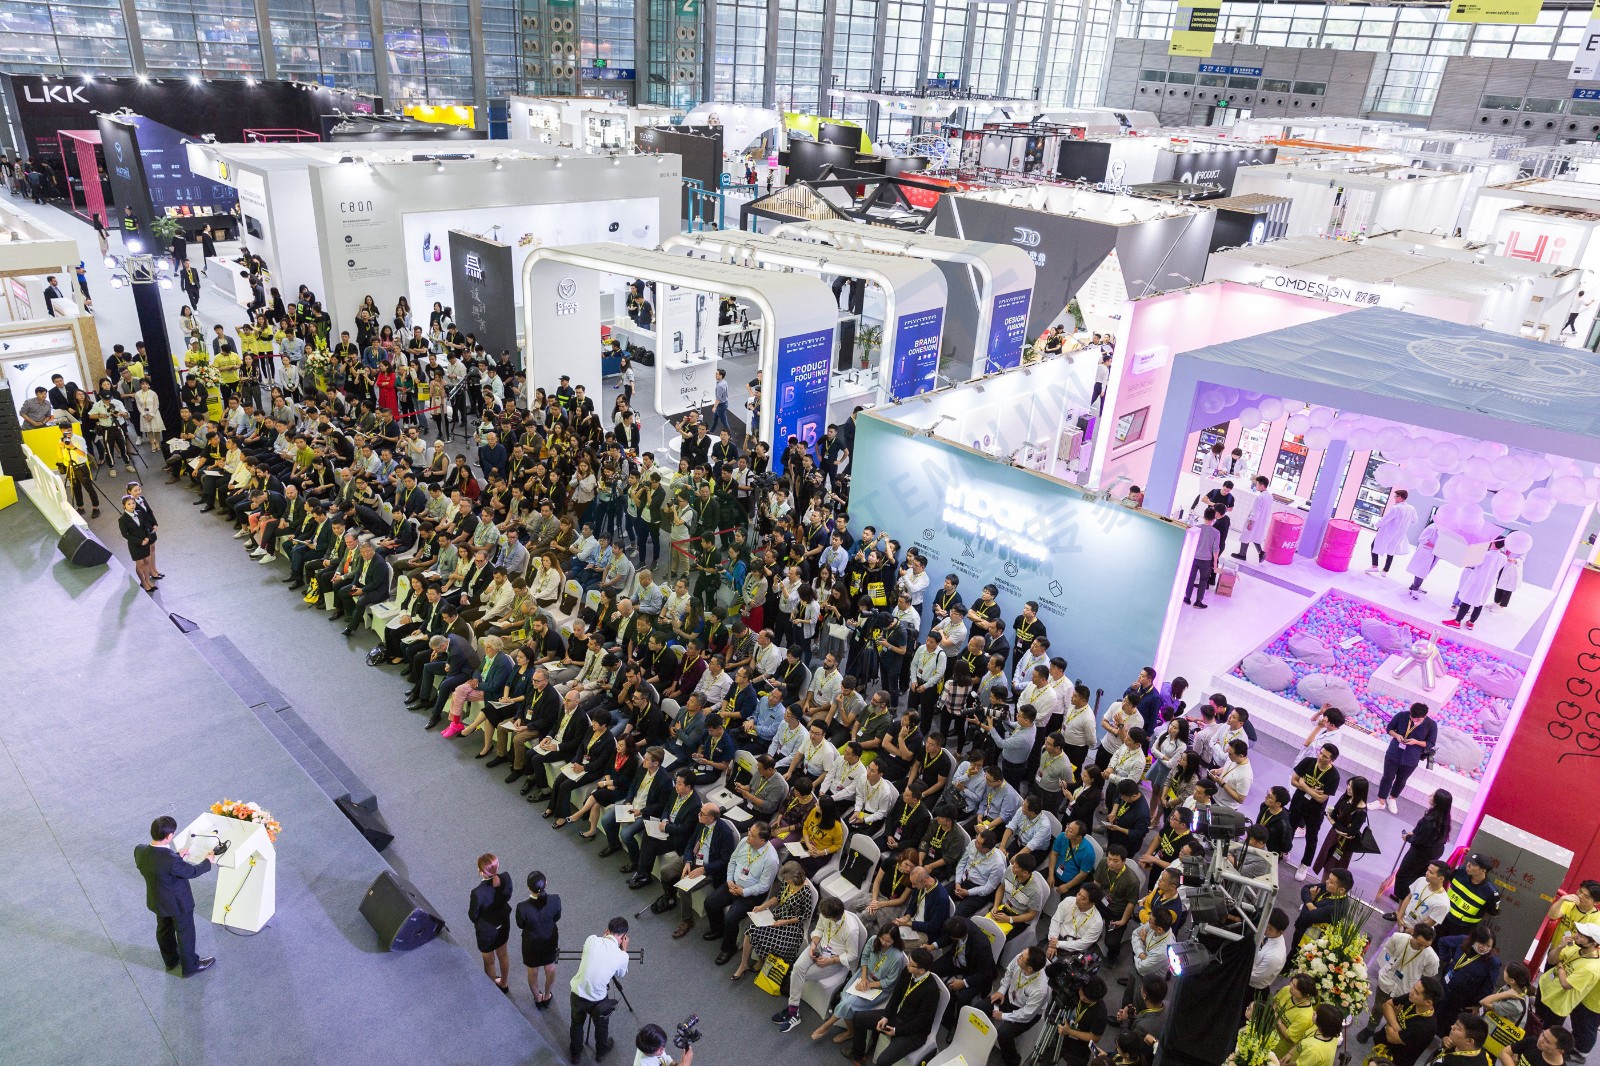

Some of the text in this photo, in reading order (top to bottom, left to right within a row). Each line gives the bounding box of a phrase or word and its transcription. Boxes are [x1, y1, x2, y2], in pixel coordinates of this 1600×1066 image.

[683, 0, 694, 11] 2
[23, 85, 90, 103] LKK
[1275, 276, 1351, 299] OMDESIGN
[1004, 315, 1025, 326] DESIGN
[914, 336, 937, 348] BRAND
[791, 359, 827, 376] PRODUCT
[1505, 1025, 1521, 1039] 2018
